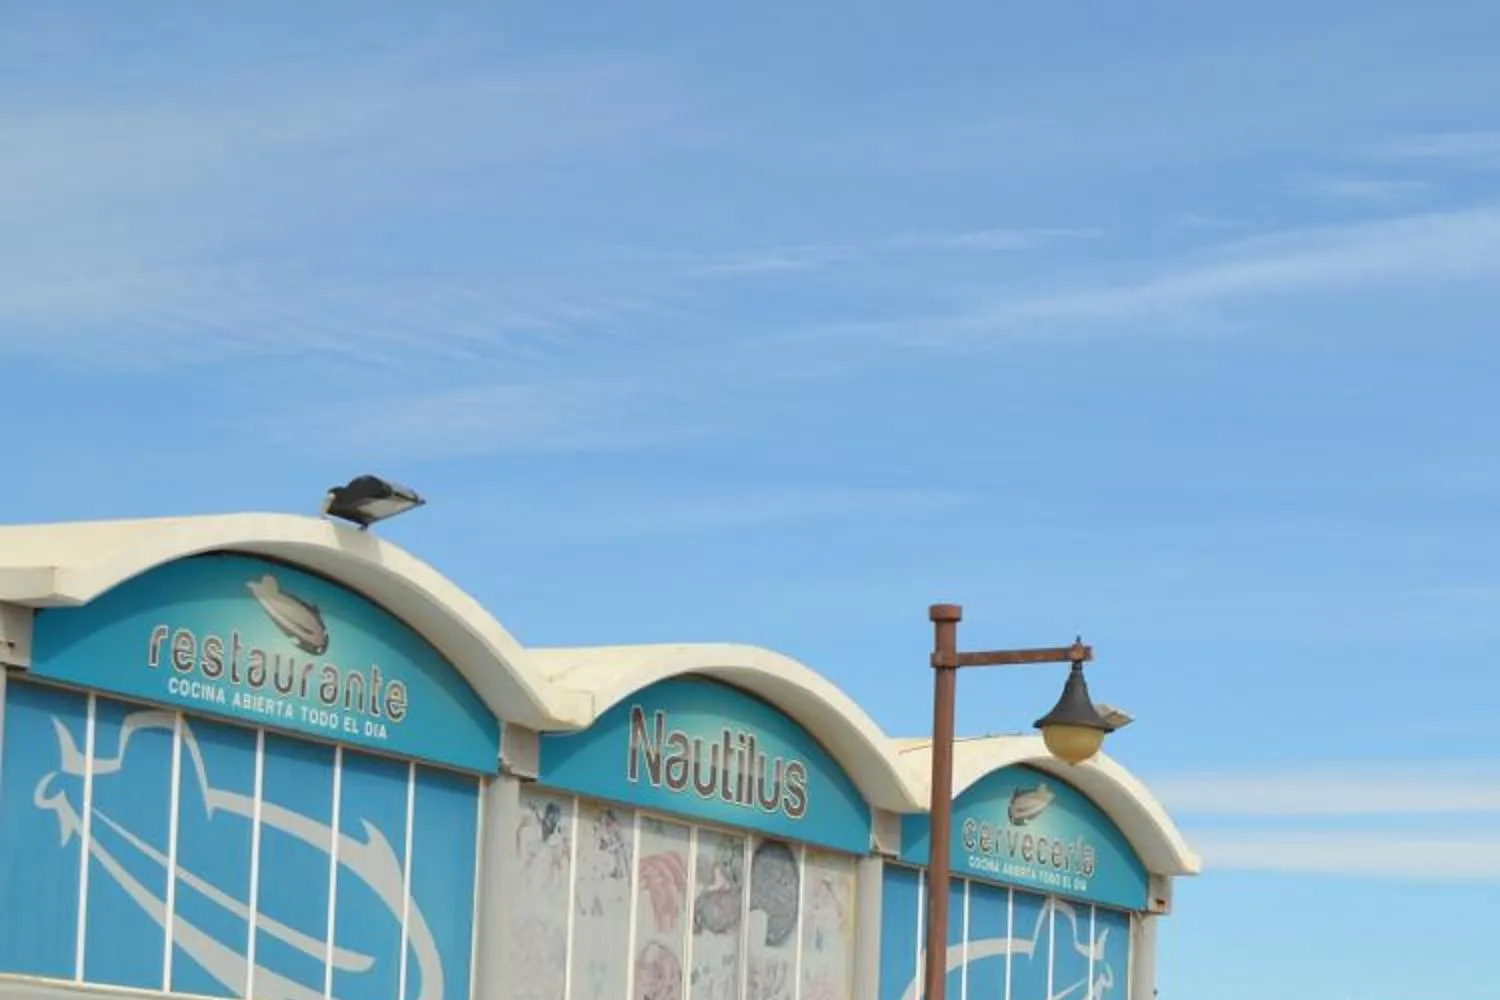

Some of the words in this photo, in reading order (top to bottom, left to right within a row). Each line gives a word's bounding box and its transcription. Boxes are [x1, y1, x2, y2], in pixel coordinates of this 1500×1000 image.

[148, 624, 408, 722] restaurante
[168, 676, 226, 706] COCINA
[232, 692, 293, 718] ABIERTA
[301, 705, 339, 729] TODO
[343, 716, 359, 734] EL
[364, 721, 388, 739] DIA
[627, 703, 808, 820] Nautilus
